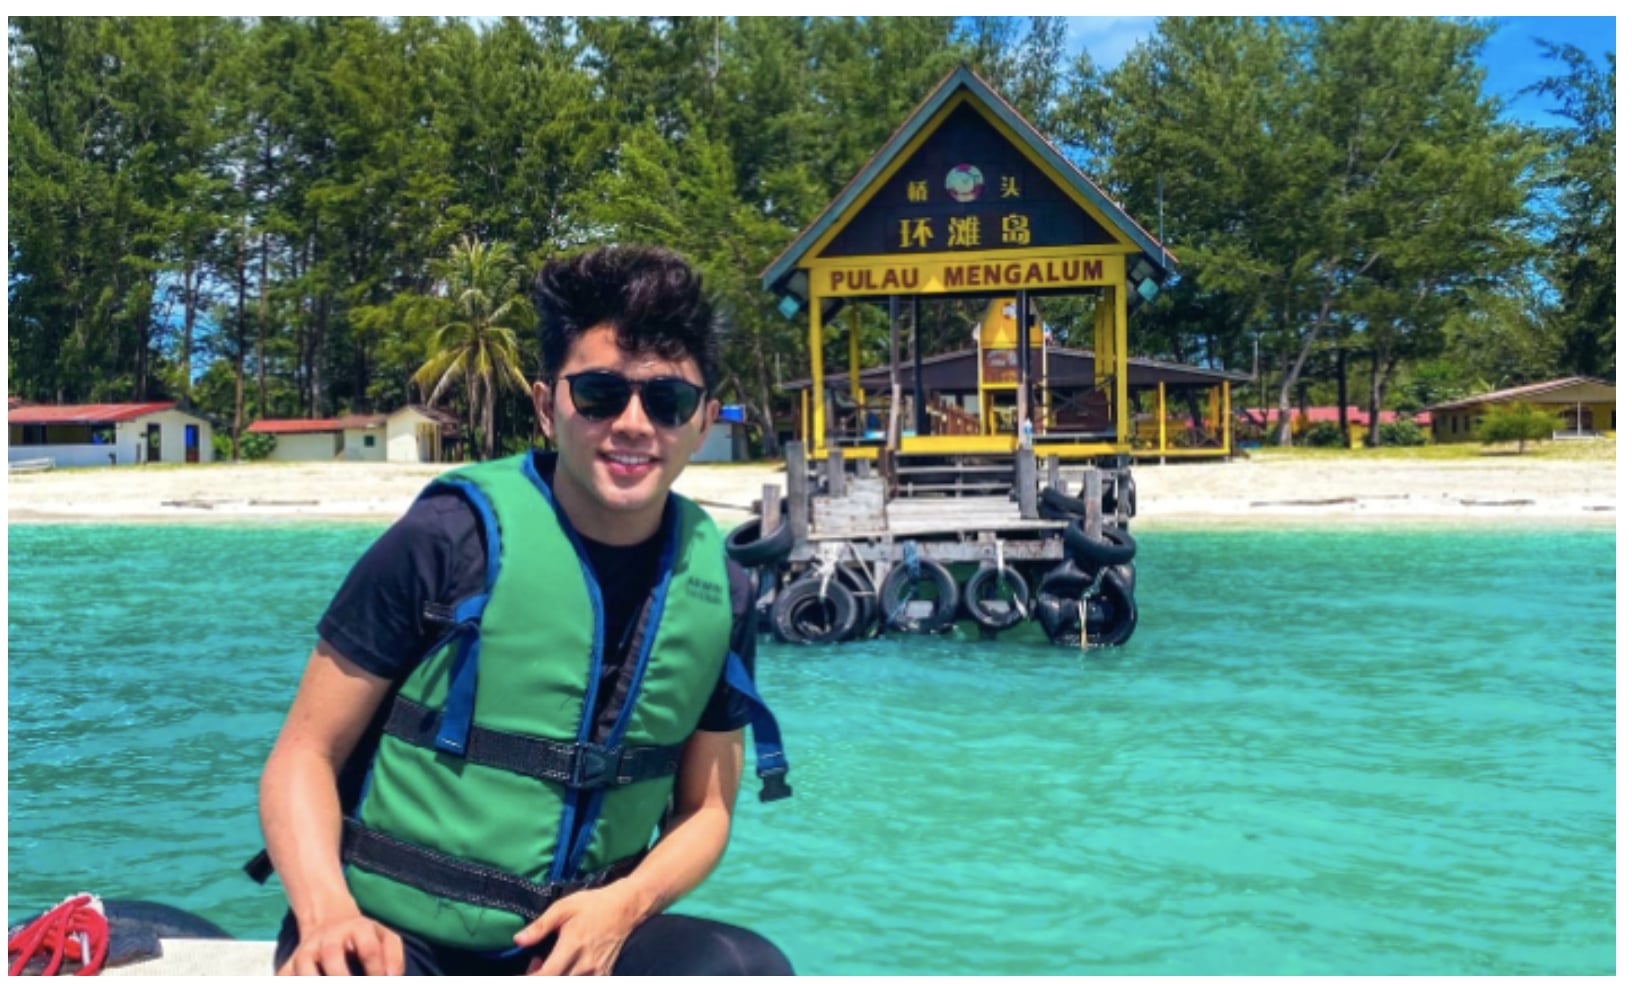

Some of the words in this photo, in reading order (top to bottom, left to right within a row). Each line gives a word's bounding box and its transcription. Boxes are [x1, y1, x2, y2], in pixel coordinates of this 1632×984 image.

[898, 214, 1031, 248] 环滩岛
[830, 267, 919, 291] PULAU
[943, 260, 1103, 288] MENGALUM
